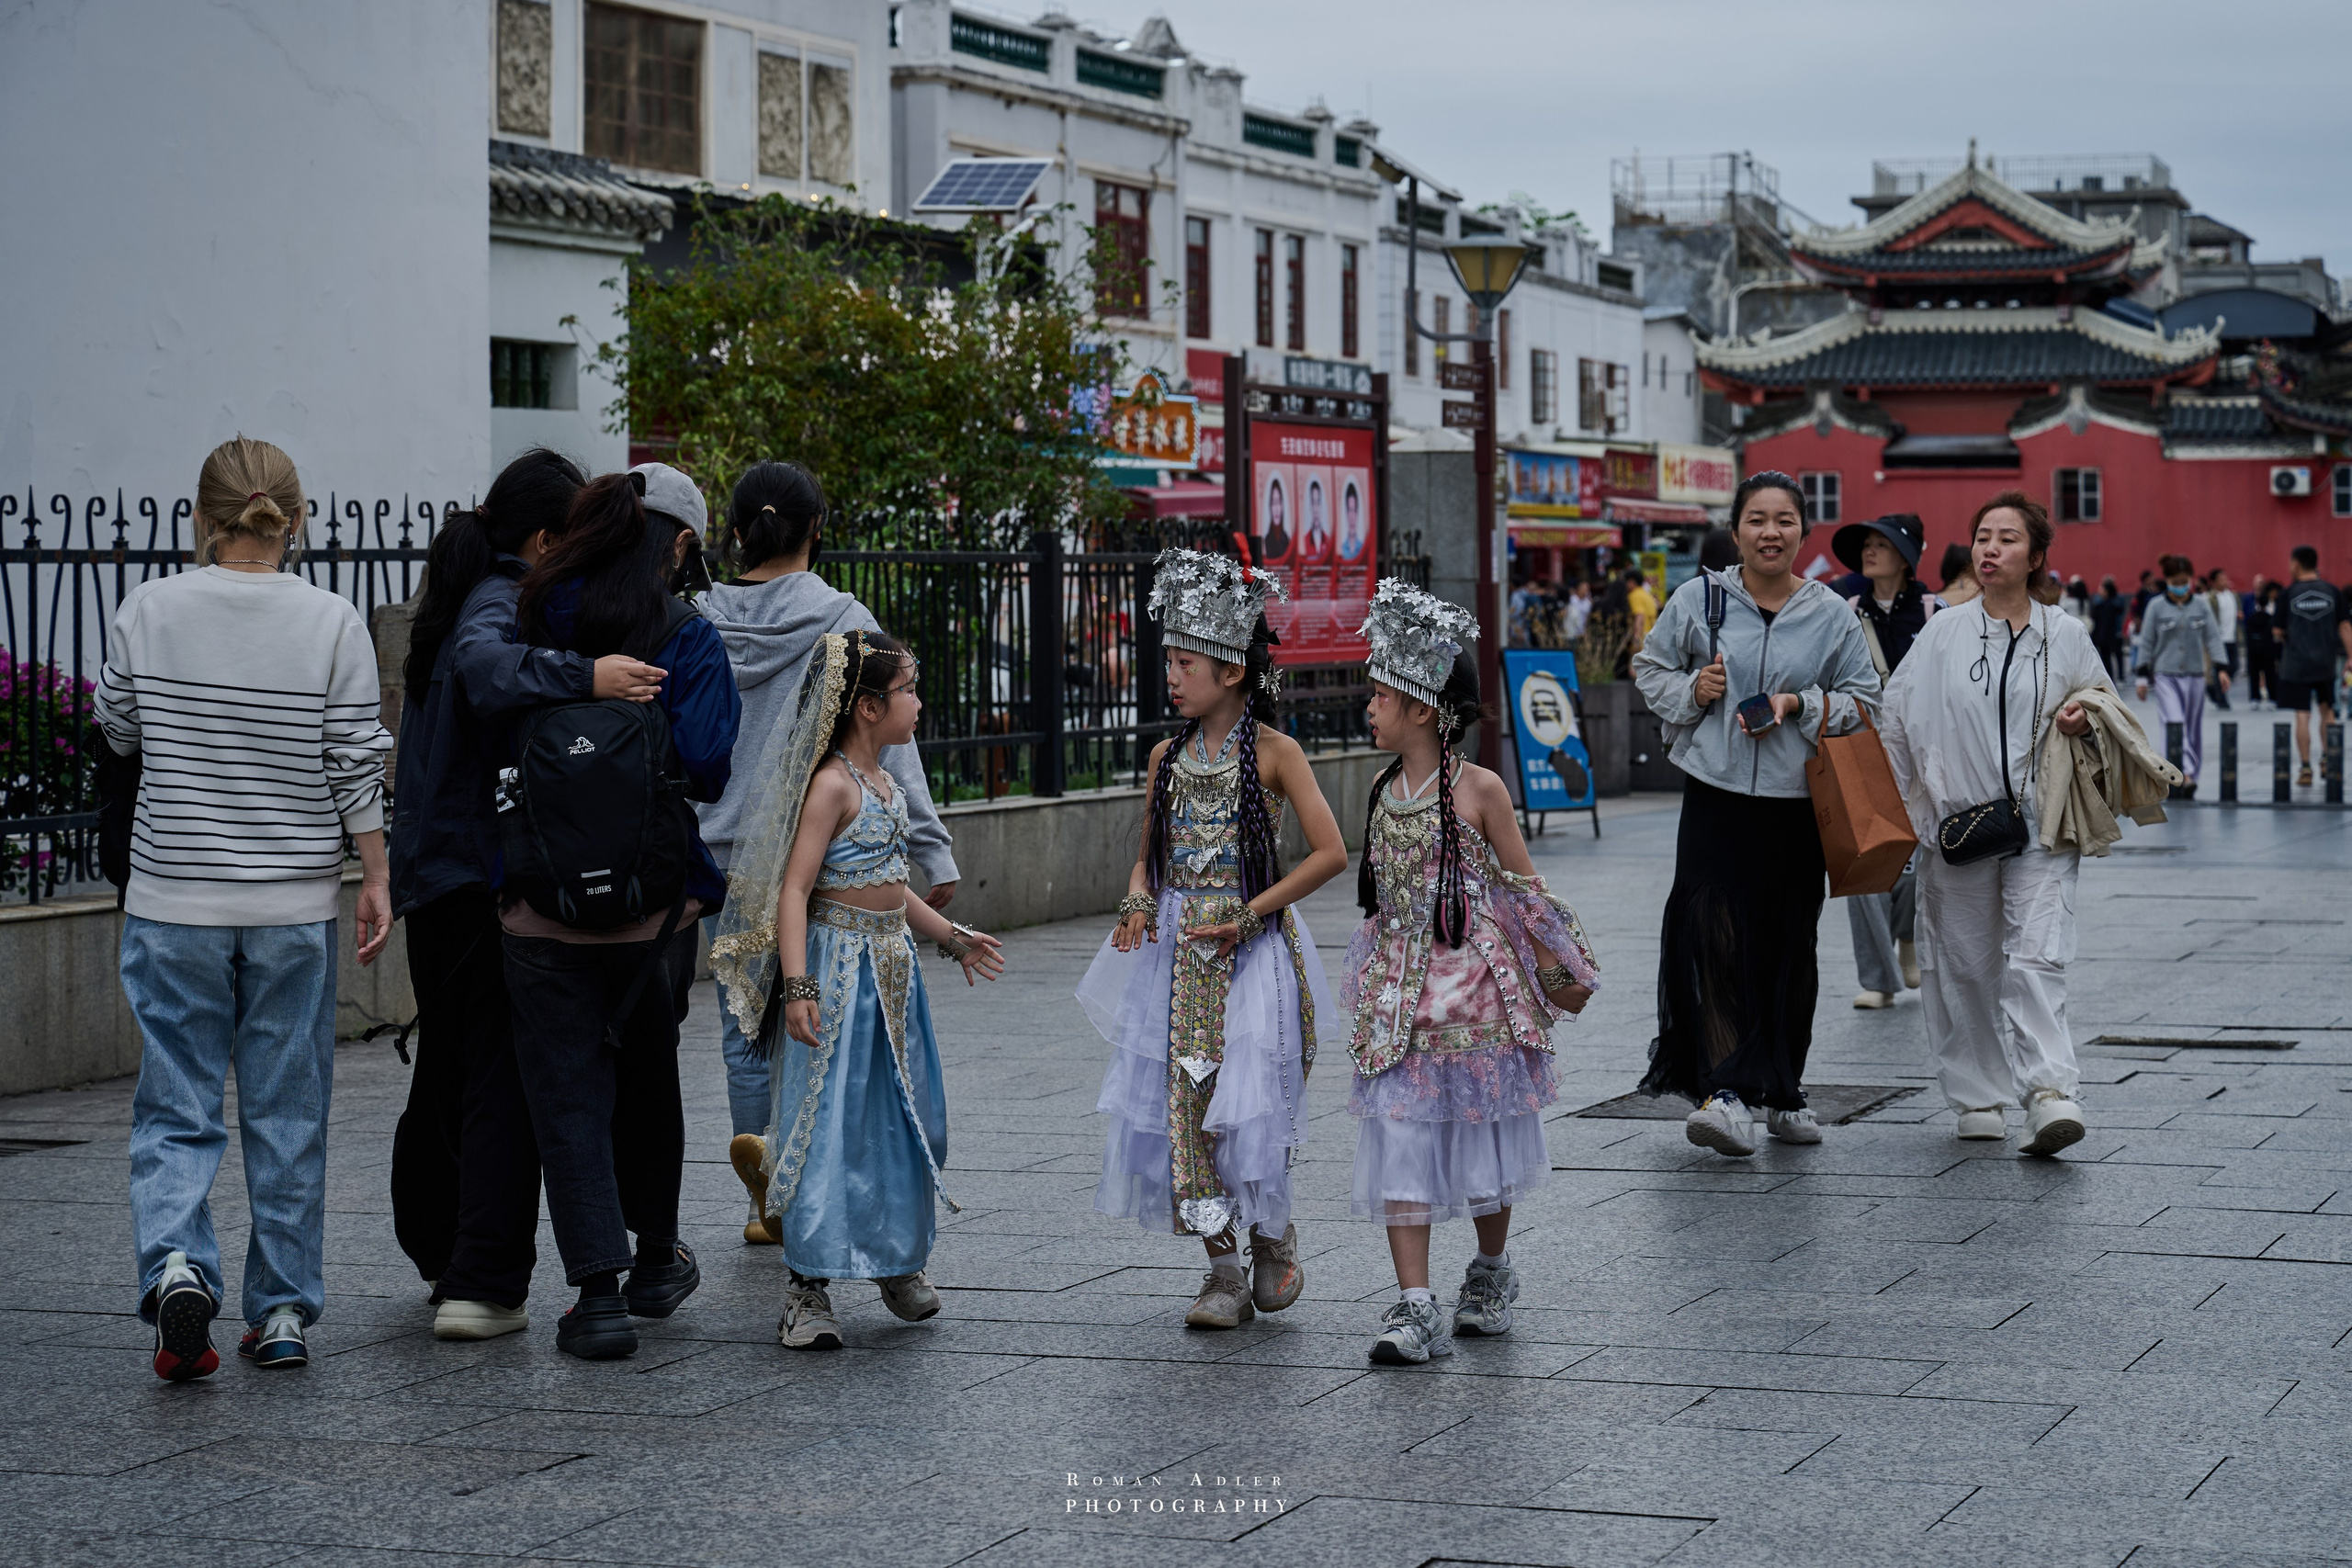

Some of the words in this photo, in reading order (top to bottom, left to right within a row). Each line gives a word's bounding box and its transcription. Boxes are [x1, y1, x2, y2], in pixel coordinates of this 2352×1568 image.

[569, 747, 596, 756] PELLIOT
[586, 887, 594, 896] 20
[594, 885, 612, 895] LITERS
[1385, 1315, 1406, 1326] Queen
